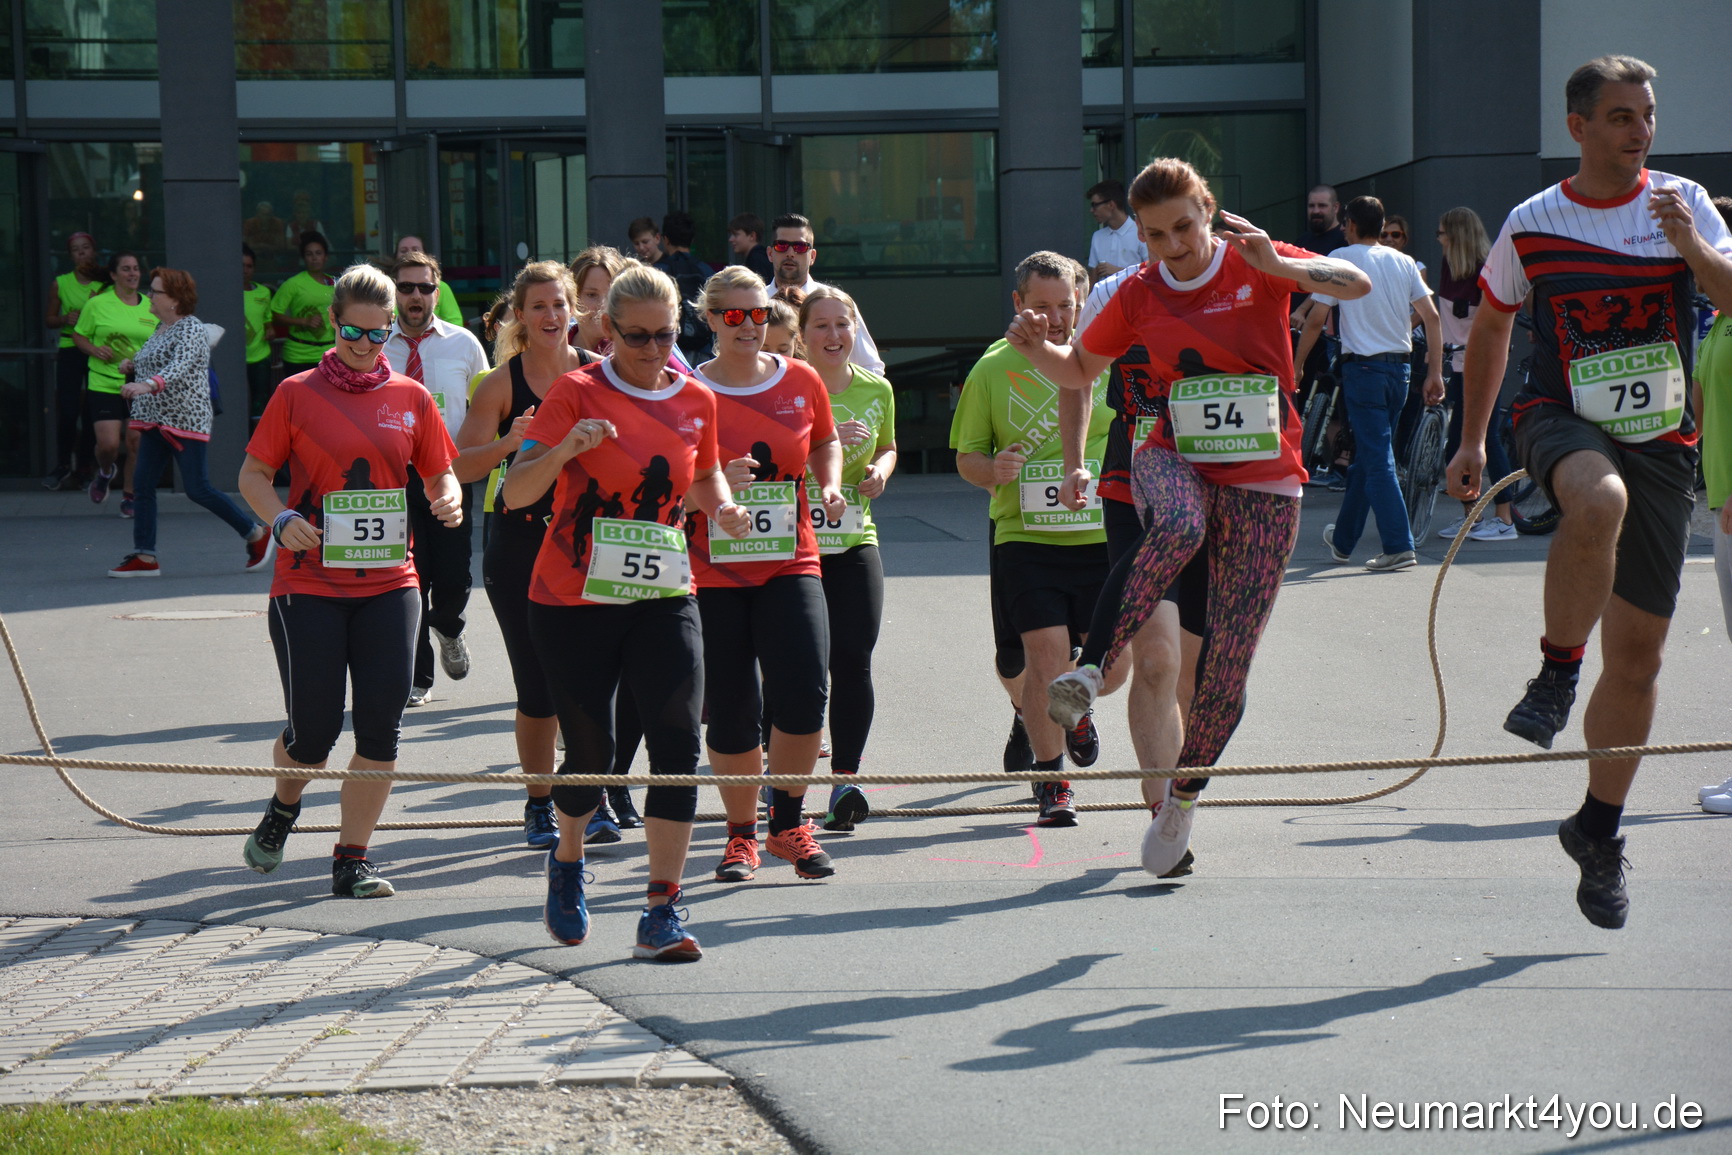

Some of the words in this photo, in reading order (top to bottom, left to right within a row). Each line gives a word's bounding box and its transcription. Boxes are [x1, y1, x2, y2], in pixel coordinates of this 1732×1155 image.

[1578, 346, 1672, 383] BOCK
[1178, 377, 1269, 399] BOCK
[1609, 381, 1651, 412] 79
[1203, 402, 1244, 430] 54
[1601, 415, 1663, 434] RAINER
[1193, 437, 1260, 452] KORONA
[331, 492, 401, 511] BOCK
[732, 485, 789, 503] OCK
[1034, 512, 1091, 523] STEPHAN
[354, 518, 385, 541] 53
[601, 522, 682, 552] BOCK
[344, 548, 391, 559] SABINE
[729, 540, 779, 553] NICOLE
[621, 552, 661, 580] 55
[612, 584, 660, 599] TANJA
